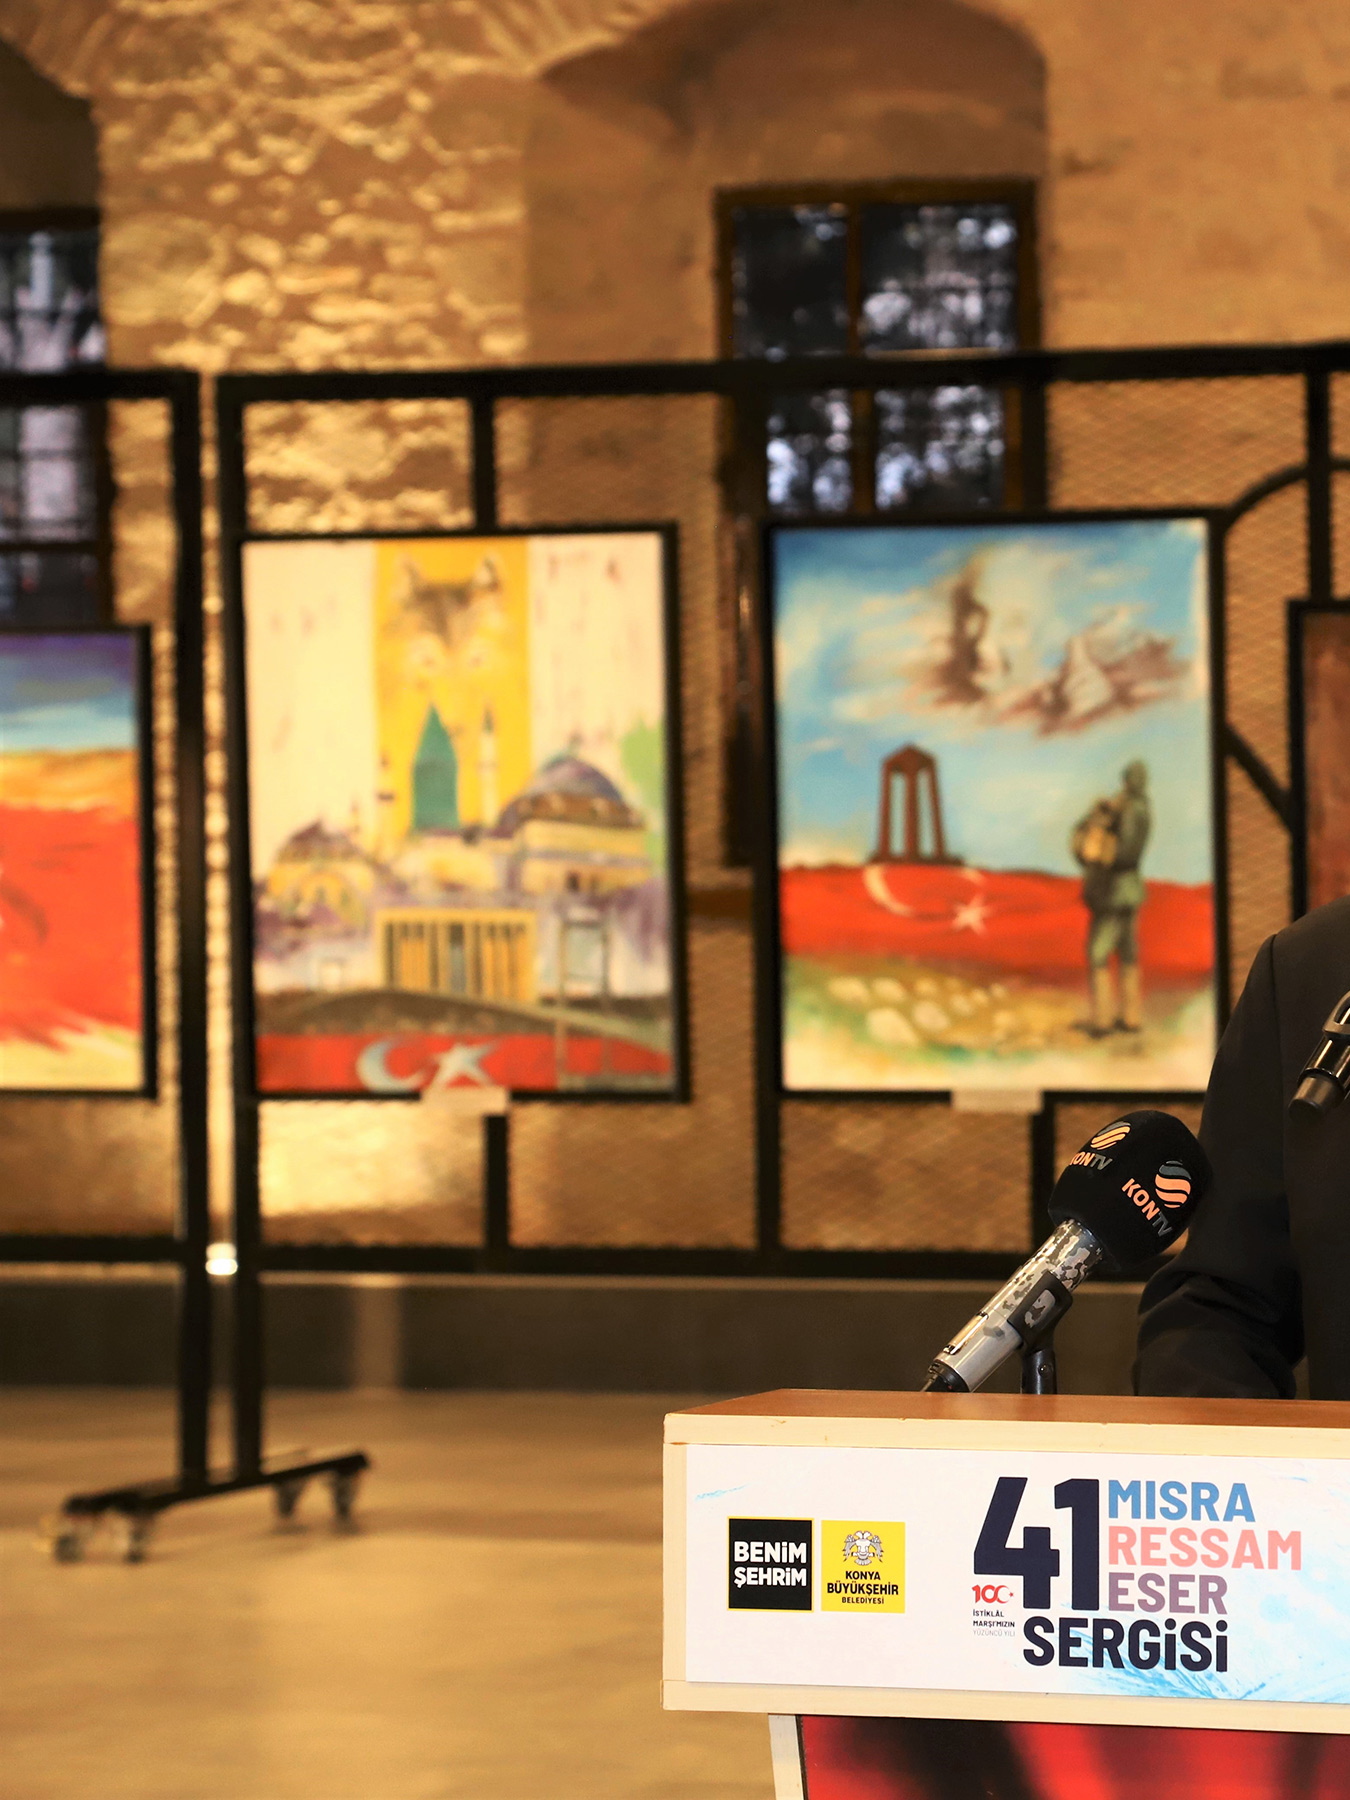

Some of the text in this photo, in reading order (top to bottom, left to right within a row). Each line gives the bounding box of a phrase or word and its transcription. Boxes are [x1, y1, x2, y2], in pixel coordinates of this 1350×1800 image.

[1121, 1178, 1173, 1237] KONTV
[974, 1476, 1256, 1611] 41 MISRA
[1108, 1526, 1302, 1571] RESSAM
[827, 1580, 899, 1596] BÜYÜKŞEHİR
[845, 1570, 881, 1581] KONYA
[1108, 1572, 1228, 1615] ESER
[841, 1596, 885, 1605] BELEDİYESİ
